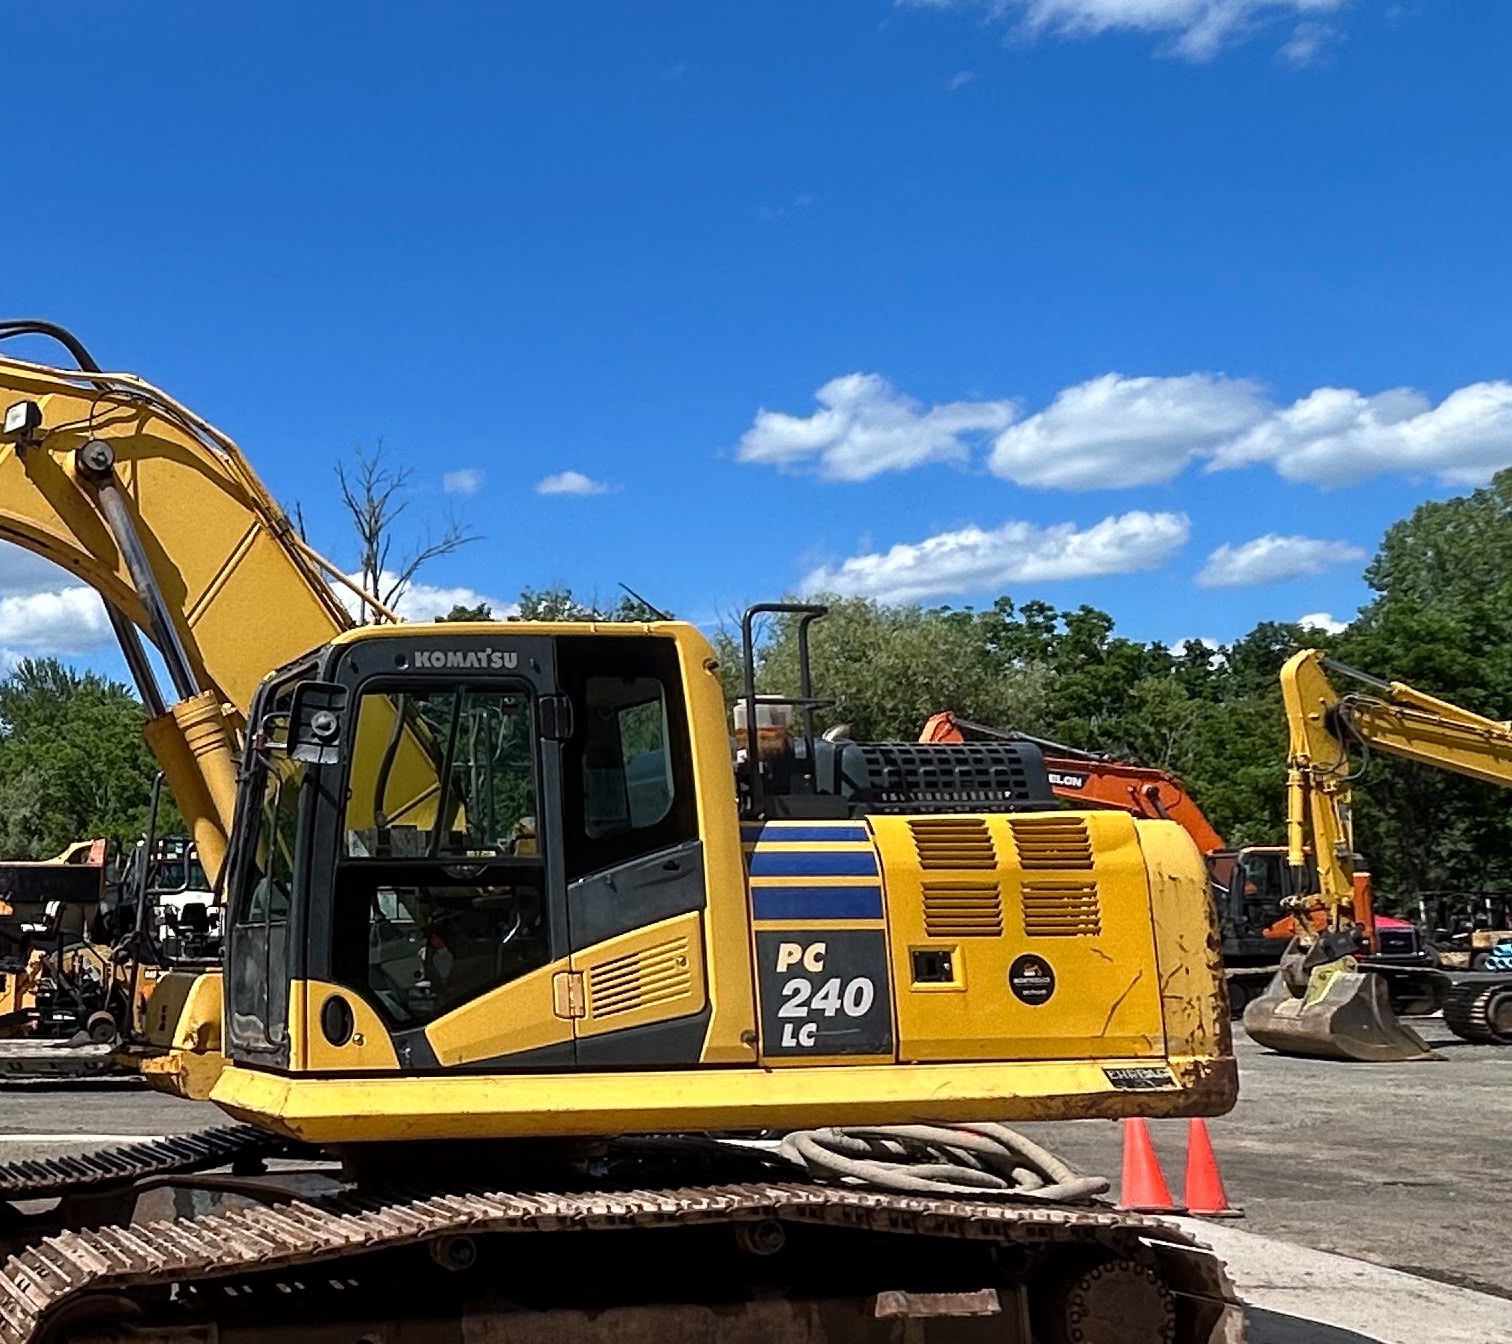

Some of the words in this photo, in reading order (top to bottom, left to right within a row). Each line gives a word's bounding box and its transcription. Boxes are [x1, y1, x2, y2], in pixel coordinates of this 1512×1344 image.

[414, 647, 518, 669] KOMATSU
[1048, 773, 1082, 787] ELON
[776, 942, 827, 973] PC
[777, 976, 875, 1018] 240
[781, 1022, 818, 1048] LC
